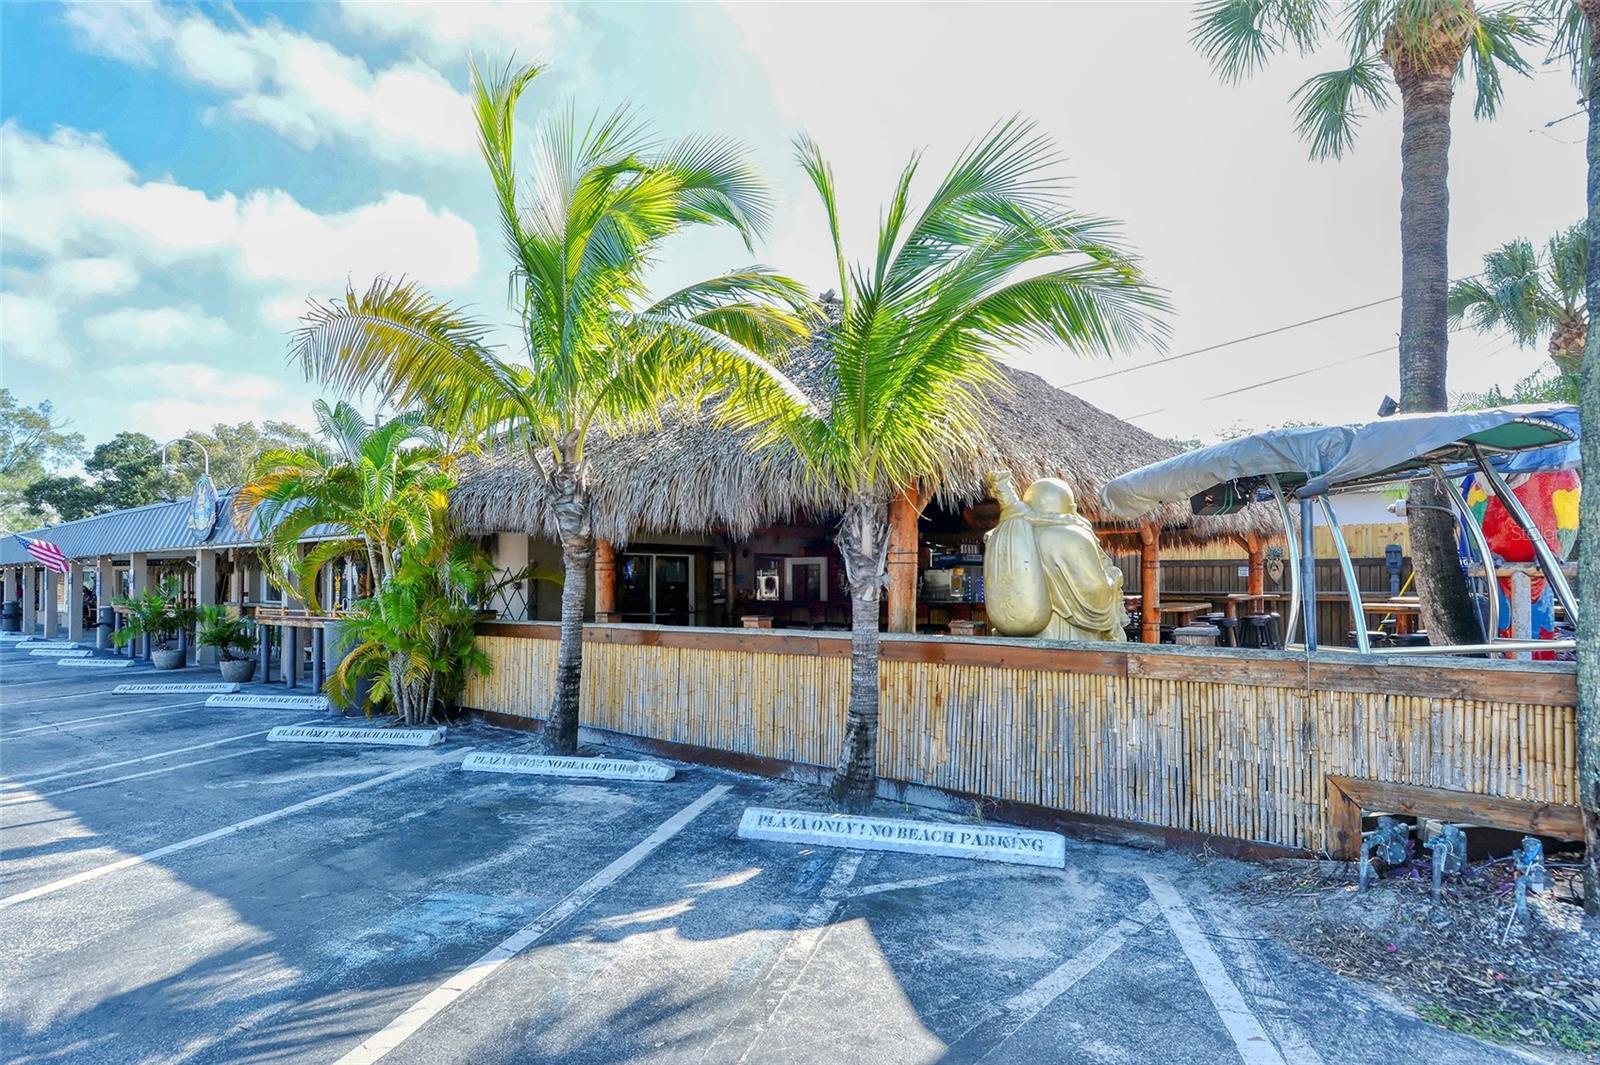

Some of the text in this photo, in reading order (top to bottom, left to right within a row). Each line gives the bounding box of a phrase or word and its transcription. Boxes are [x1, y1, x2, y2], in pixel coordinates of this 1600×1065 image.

[277, 729, 306, 737] PLAZA
[349, 730, 379, 739] BEACH
[380, 731, 423, 739] PARKING
[473, 755, 507, 766] PLAZA
[546, 759, 561, 769] NO
[561, 760, 600, 771] BEACH
[602, 762, 656, 774] PARNG
[758, 814, 807, 830] PLAZA
[868, 825, 893, 838] NO
[896, 826, 954, 843] BEACH
[959, 832, 1044, 852] PARKING
